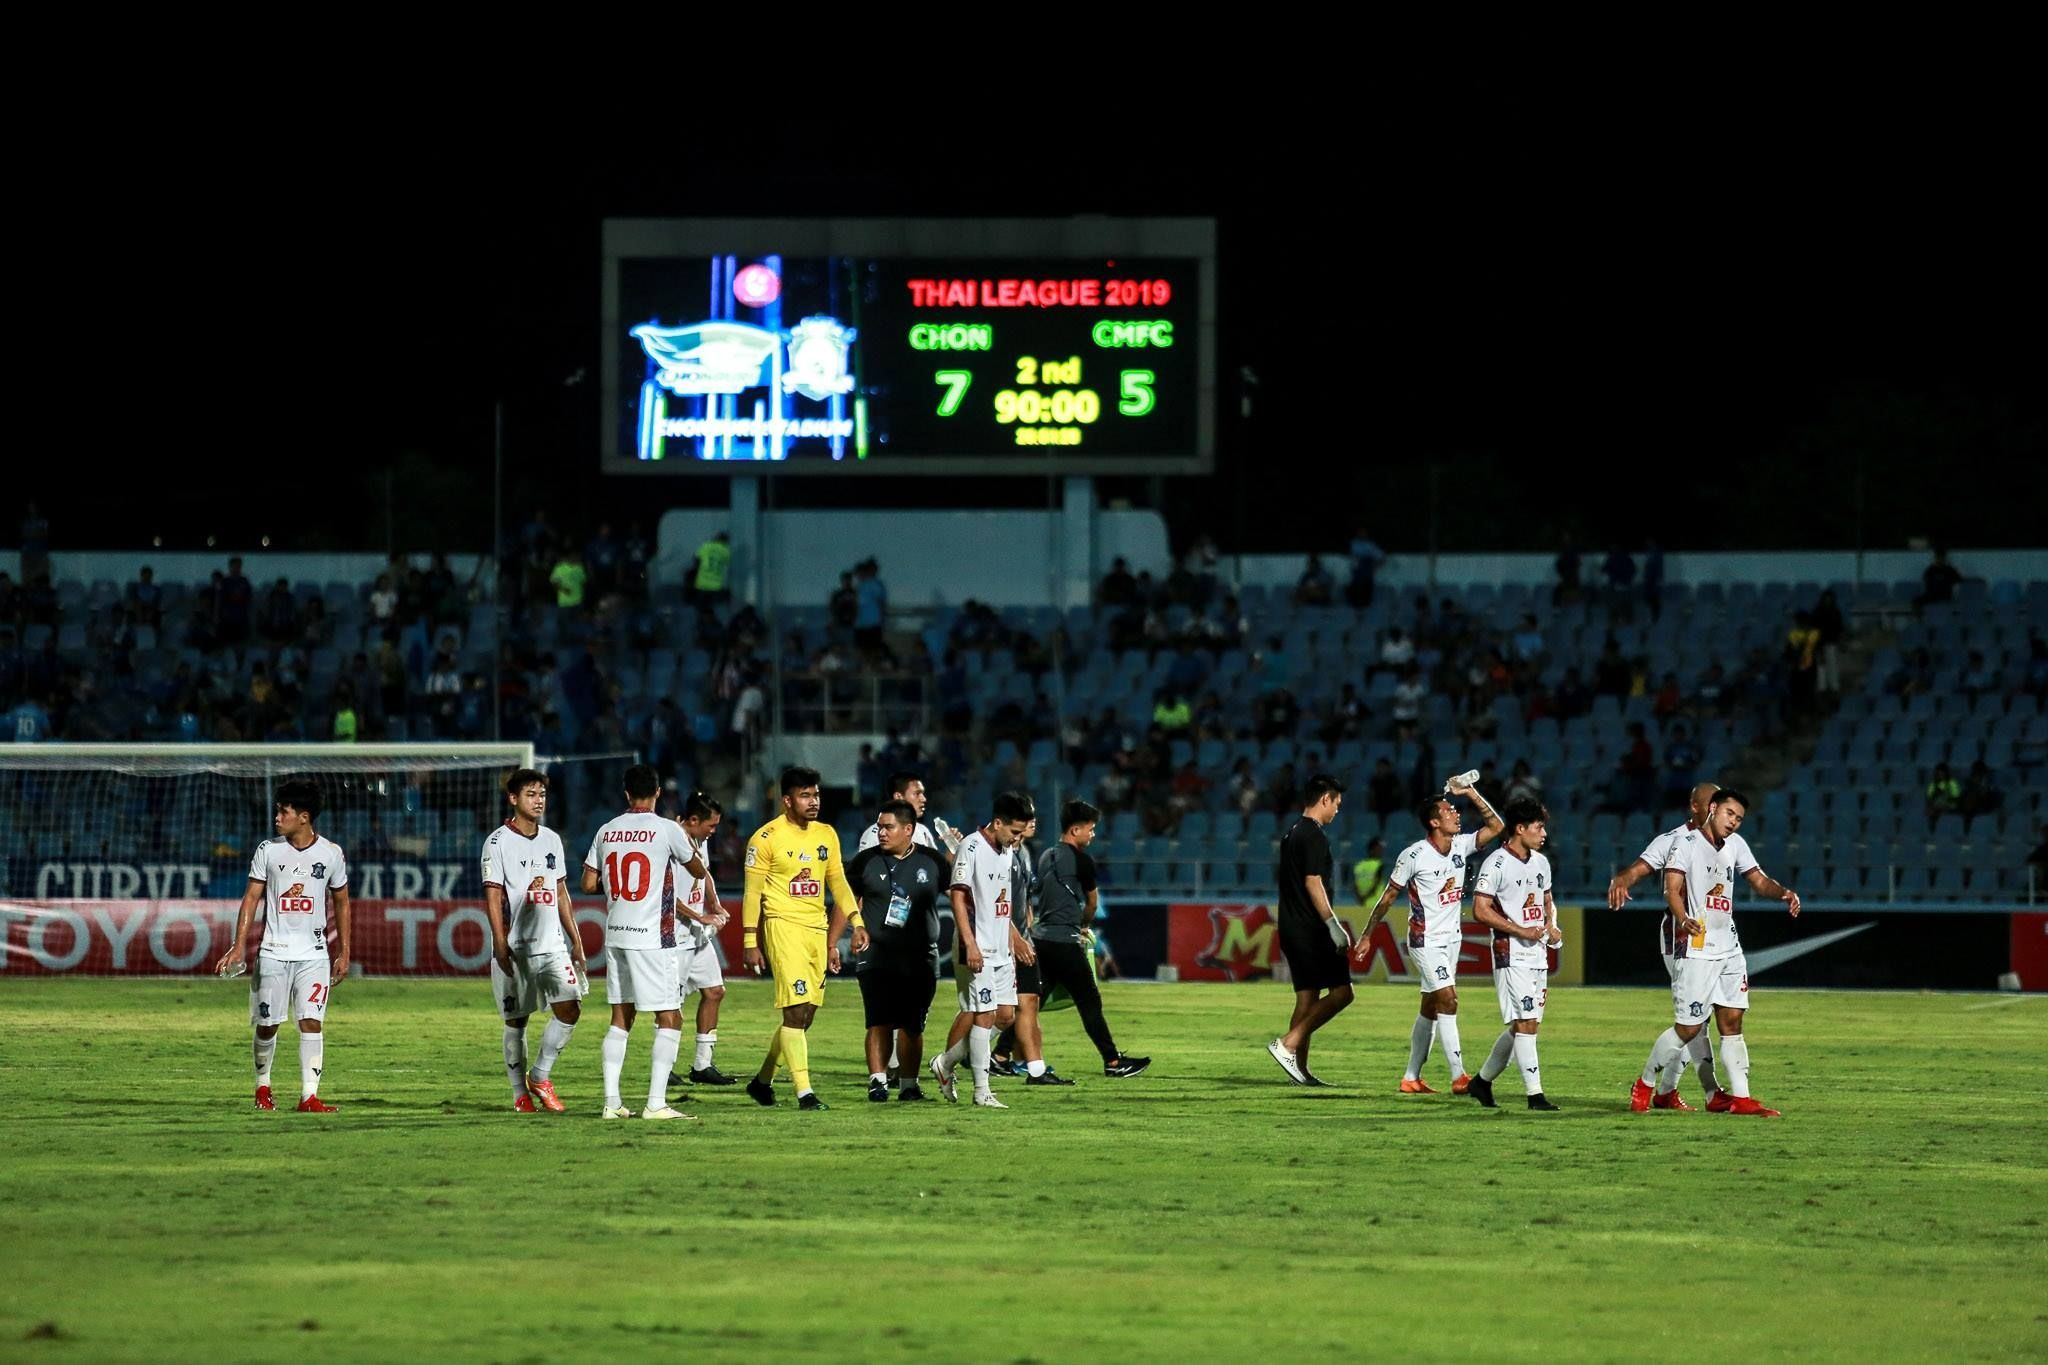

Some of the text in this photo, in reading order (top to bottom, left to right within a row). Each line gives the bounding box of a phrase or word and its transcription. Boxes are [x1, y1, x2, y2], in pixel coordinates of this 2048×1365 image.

[907, 279, 1171, 307] THAI LEAGUE 2019
[909, 323, 992, 350] CHON
[1092, 319, 1173, 348] CMFC
[1016, 355, 1081, 384] 2 nd
[935, 369, 972, 416] 7
[1119, 369, 1154, 416] 5
[995, 390, 1099, 423] 90:00
[602, 830, 657, 843] AZADZOY
[37, 862, 210, 900] CURVE
[605, 851, 650, 902] 10
[791, 883, 819, 896] LEO
[281, 899, 312, 912] LEO
[527, 891, 553, 904] LEO
[1706, 897, 1730, 911] LEO
[1523, 907, 1542, 921] LEO
[308, 983, 328, 1005] 21
